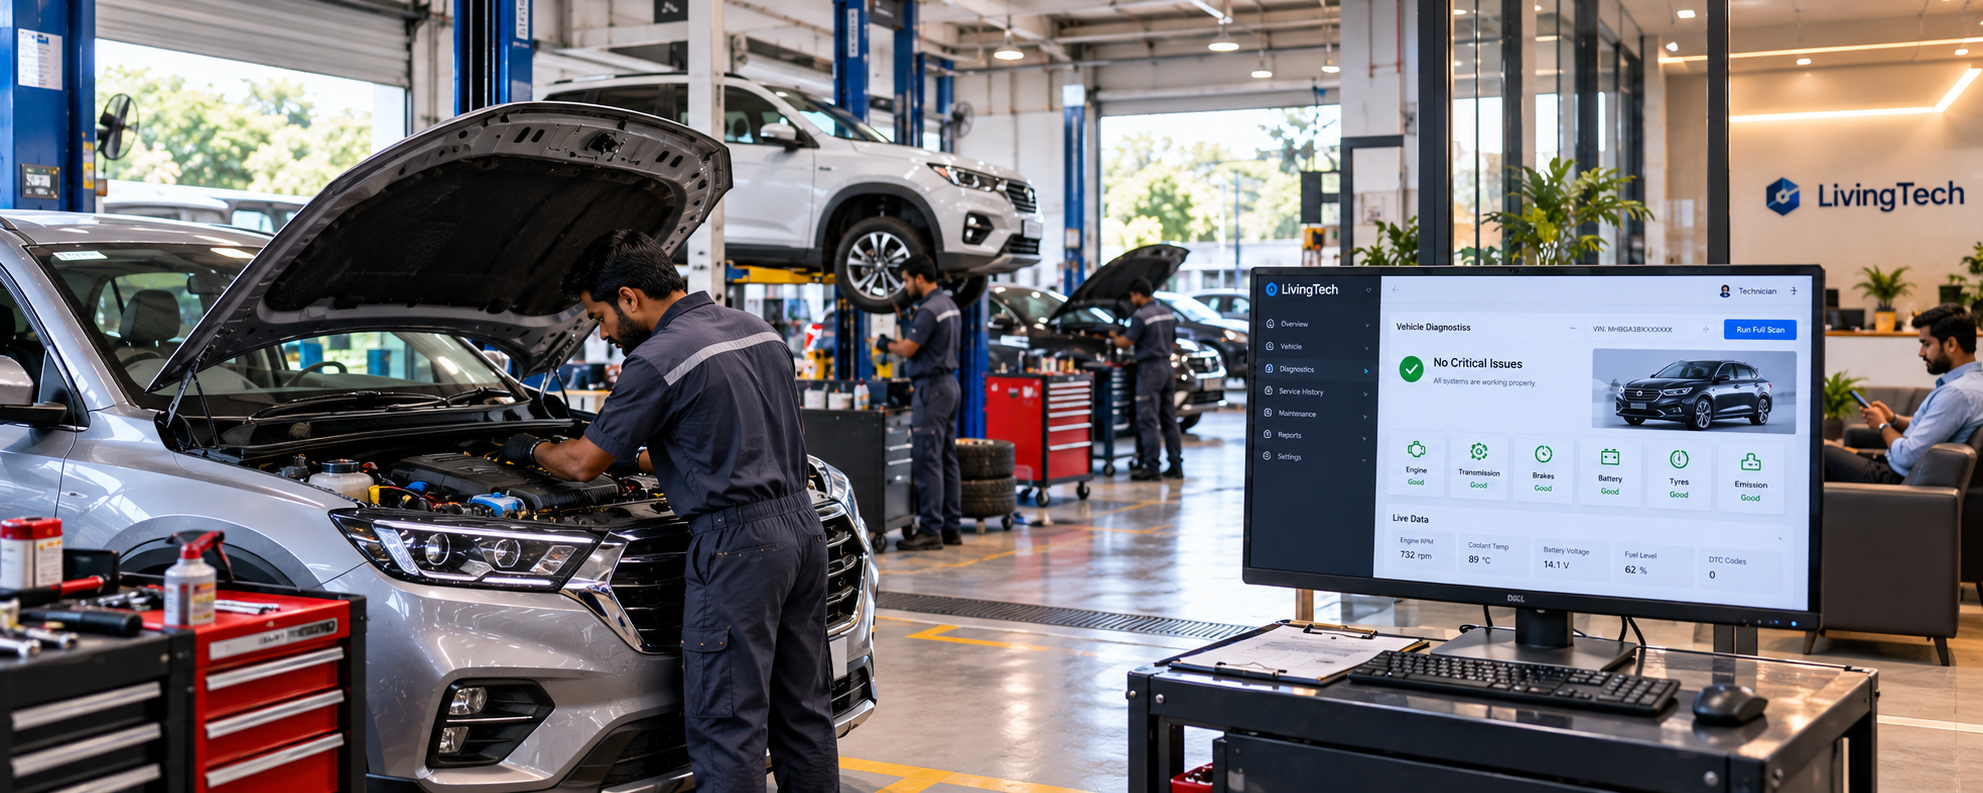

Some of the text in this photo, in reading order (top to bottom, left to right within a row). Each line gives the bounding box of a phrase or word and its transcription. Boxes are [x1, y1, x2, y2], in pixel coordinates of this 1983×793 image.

[1819, 181, 1965, 213] LivingTech
[1281, 283, 1339, 298] LivingTech
[1738, 286, 1777, 296] Technician
[1281, 320, 1309, 328] Overview
[1396, 322, 1471, 333] Vehicle Diagnostiss
[1736, 325, 1751, 333] Run
[1280, 343, 1303, 351] Vehicle
[1433, 357, 1523, 369] No Critical Issues
[1280, 365, 1315, 374] Diagnostics
[1443, 378, 1469, 386] systems
[1482, 379, 1508, 387] working
[1508, 379, 1537, 388] properly.
[1279, 387, 1324, 397] Service History
[1278, 410, 1317, 418] Maintenance
[1278, 431, 1302, 440] Reports
[1277, 453, 1302, 462] Settings
[1406, 466, 1428, 475] Engine
[1458, 468, 1501, 477] Transmission
[1532, 472, 1555, 480] Brakes
[1598, 474, 1623, 484] Battery
[1408, 478, 1425, 486] Good
[1470, 481, 1488, 489] Good
[1669, 478, 1689, 486] Tyres
[1534, 484, 1552, 492] Good
[1601, 487, 1620, 495] Good
[1669, 491, 1689, 499] Good
[1740, 494, 1760, 502] Good
[1392, 513, 1430, 524] Live Data
[1400, 537, 1419, 545] Engine
[1468, 541, 1510, 552] Coolant Temp
[1400, 550, 1432, 560] 732 rpm
[1543, 546, 1590, 557] Battery Voltage
[1468, 555, 1491, 565] 89 °C
[1708, 556, 1747, 565] DTC Codes
[1544, 560, 1570, 570] 14.1 V
[1624, 565, 1647, 574] 62 %
[1709, 570, 1716, 579] 0
